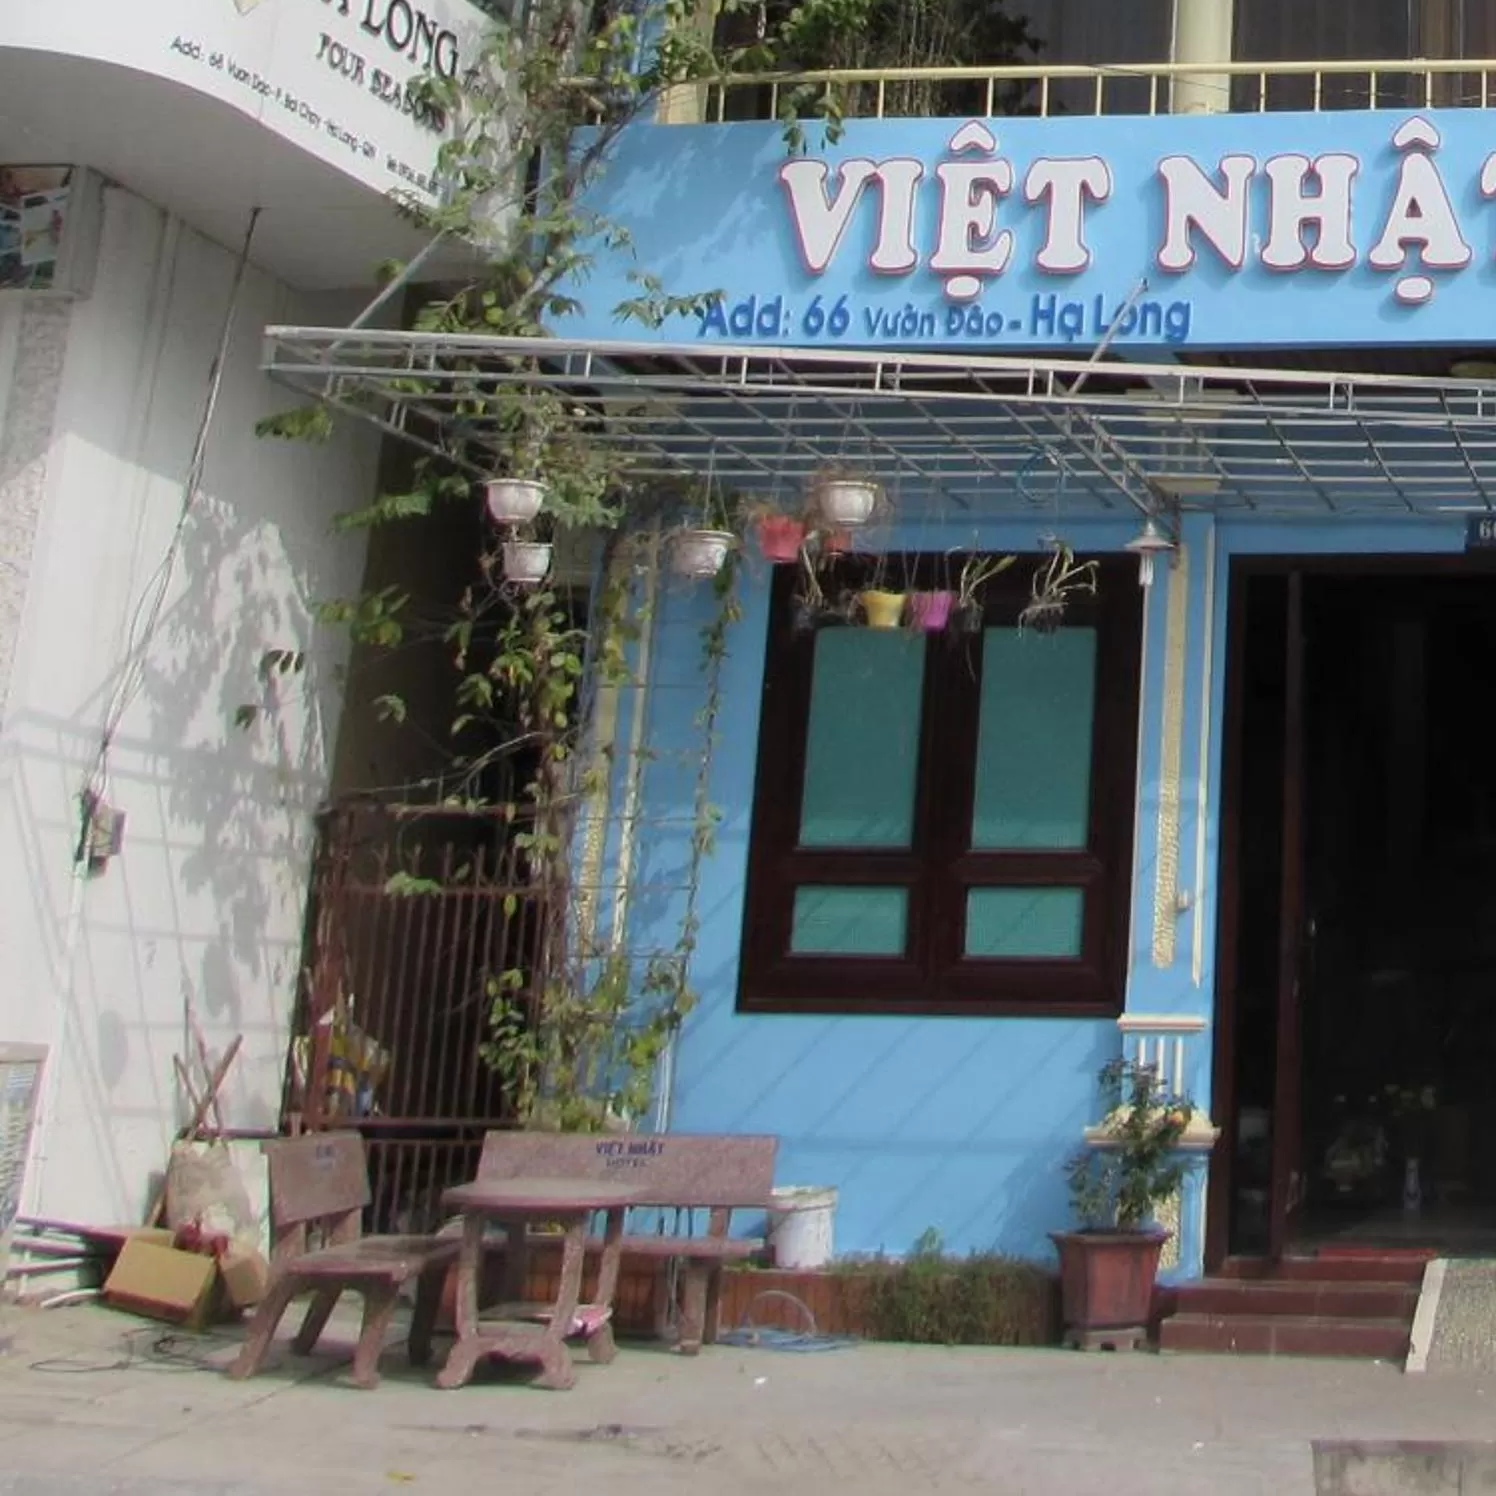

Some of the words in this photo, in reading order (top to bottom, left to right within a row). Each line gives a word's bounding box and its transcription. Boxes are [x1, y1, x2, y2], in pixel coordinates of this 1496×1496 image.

[315, 32, 366, 86] FOUR
[780, 119, 1112, 301] VIỆT
[697, 293, 791, 338] Add:
[803, 293, 850, 338] 66
